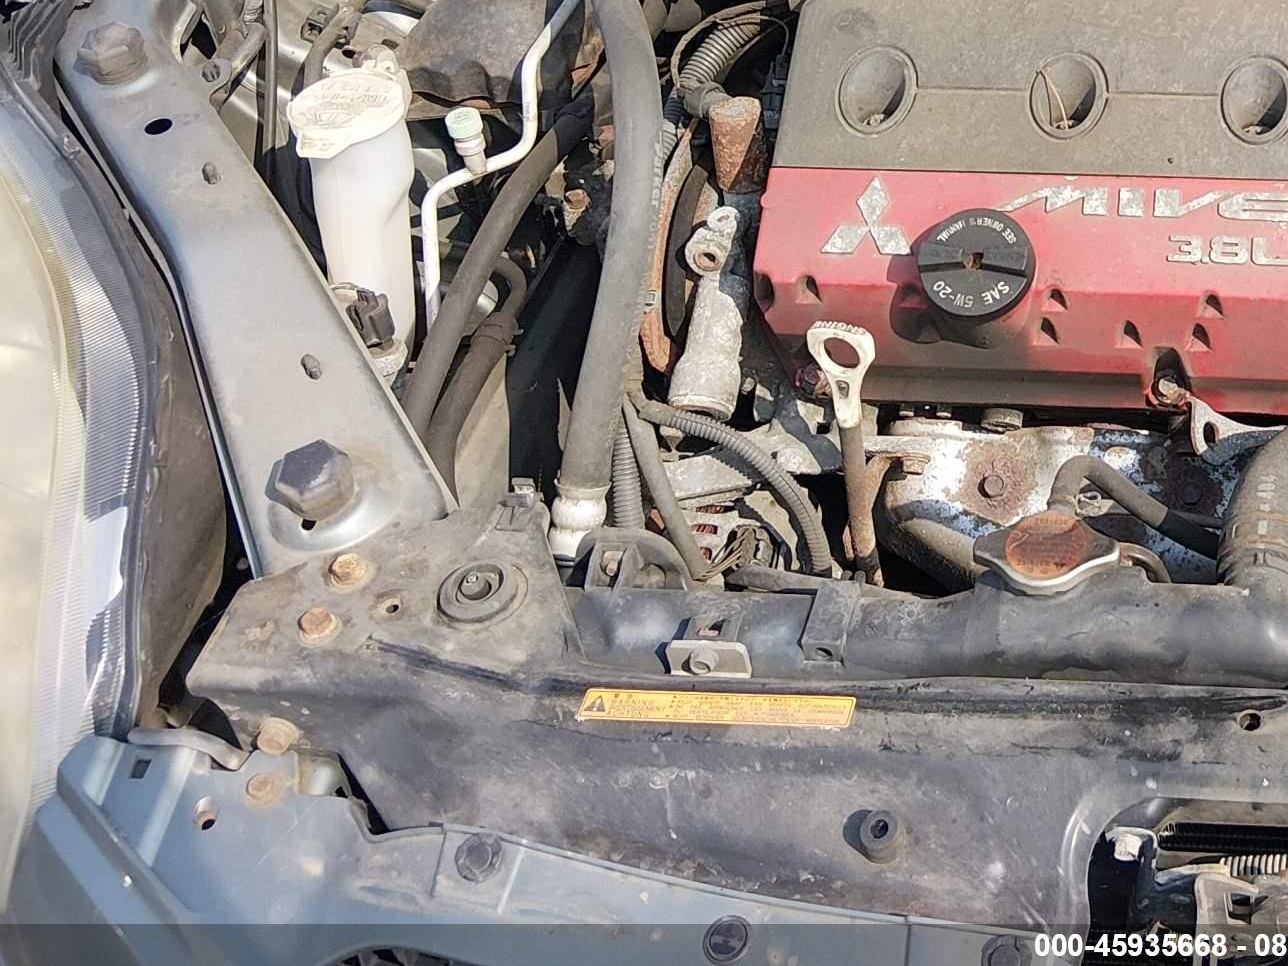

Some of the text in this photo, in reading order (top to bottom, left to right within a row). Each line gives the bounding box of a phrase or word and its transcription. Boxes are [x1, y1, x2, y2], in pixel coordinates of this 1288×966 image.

[1001, 228, 1017, 244] SEE
[1167, 234, 1288, 266] 3.8L
[932, 280, 1010, 308] SAE 5W-20
